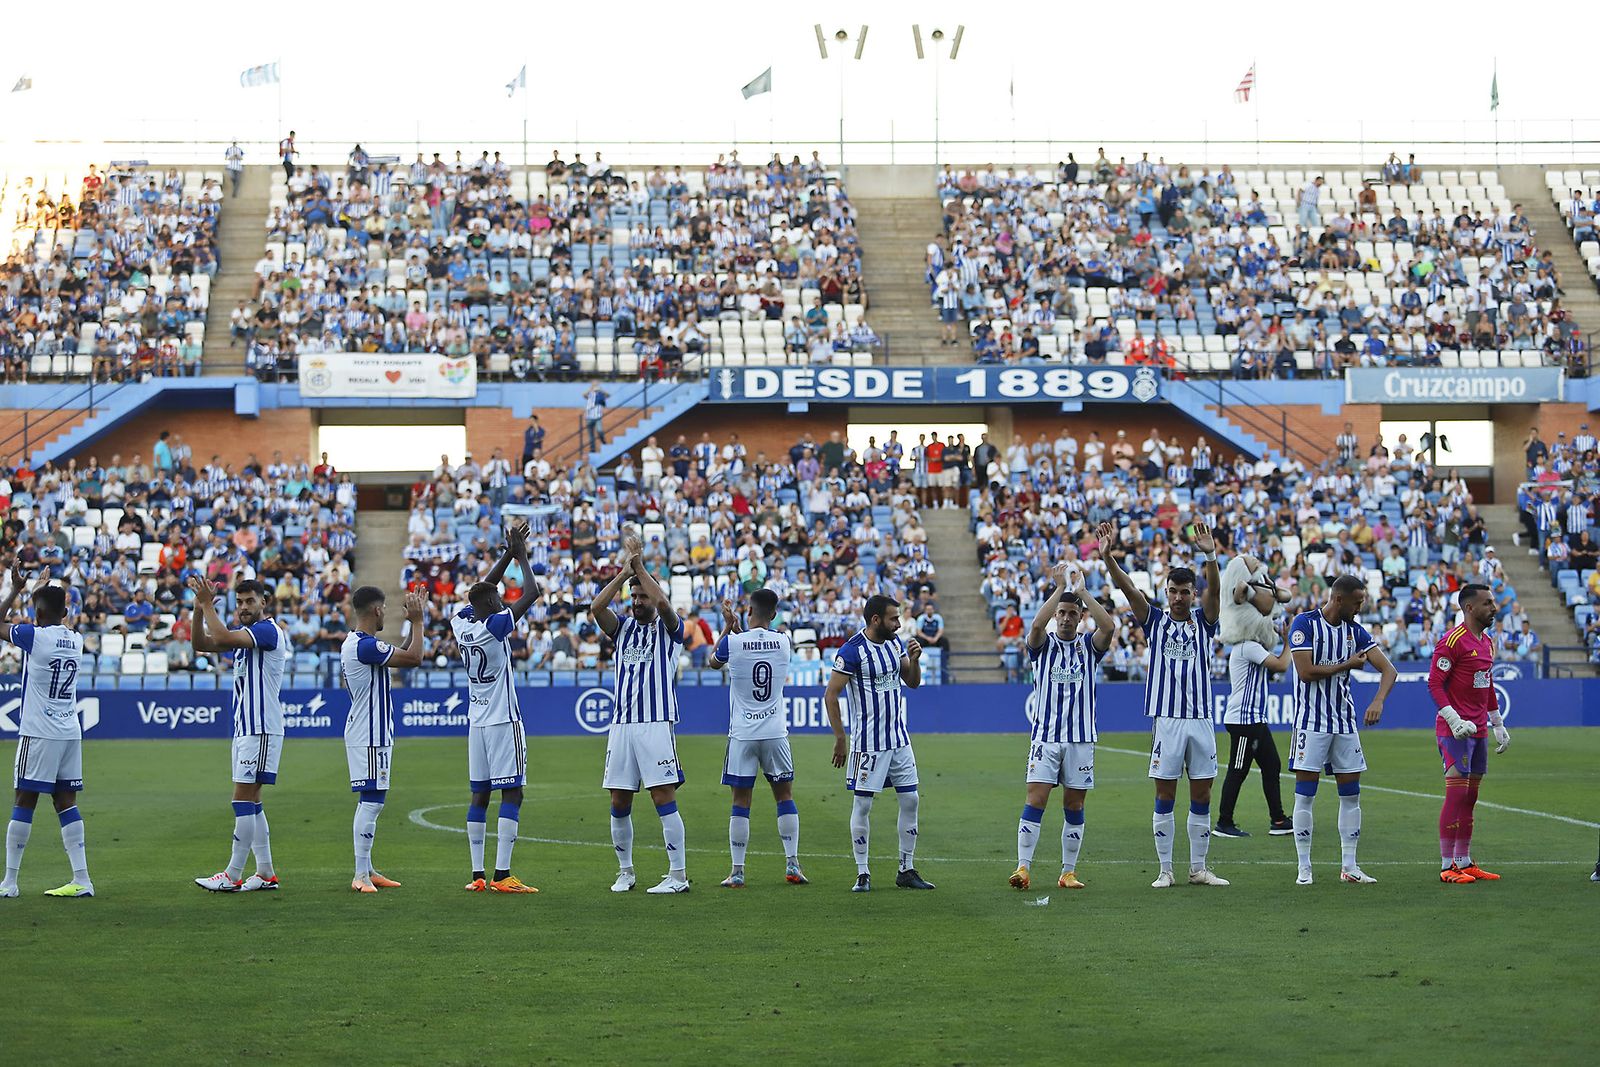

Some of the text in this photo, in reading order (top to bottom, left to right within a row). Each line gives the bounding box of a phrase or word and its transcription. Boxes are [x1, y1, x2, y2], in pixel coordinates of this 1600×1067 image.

[743, 369, 1129, 399] DESDE 1889
[1384, 371, 1526, 400] Cruzcampo
[459, 644, 497, 684] 22
[48, 658, 77, 699] 12
[752, 661, 772, 702] 9
[281, 702, 304, 714] ter
[402, 700, 440, 713] alter
[585, 698, 609, 710] RF
[137, 701, 221, 729] Veyser
[282, 715, 331, 728] ersun
[402, 714, 467, 726] enersun
[585, 711, 609, 722] EF
[1153, 741, 1162, 758] 4
[1298, 733, 1306, 750] 3
[378, 751, 389, 769] 11
[1031, 745, 1043, 761] 14
[860, 753, 877, 771] 21
